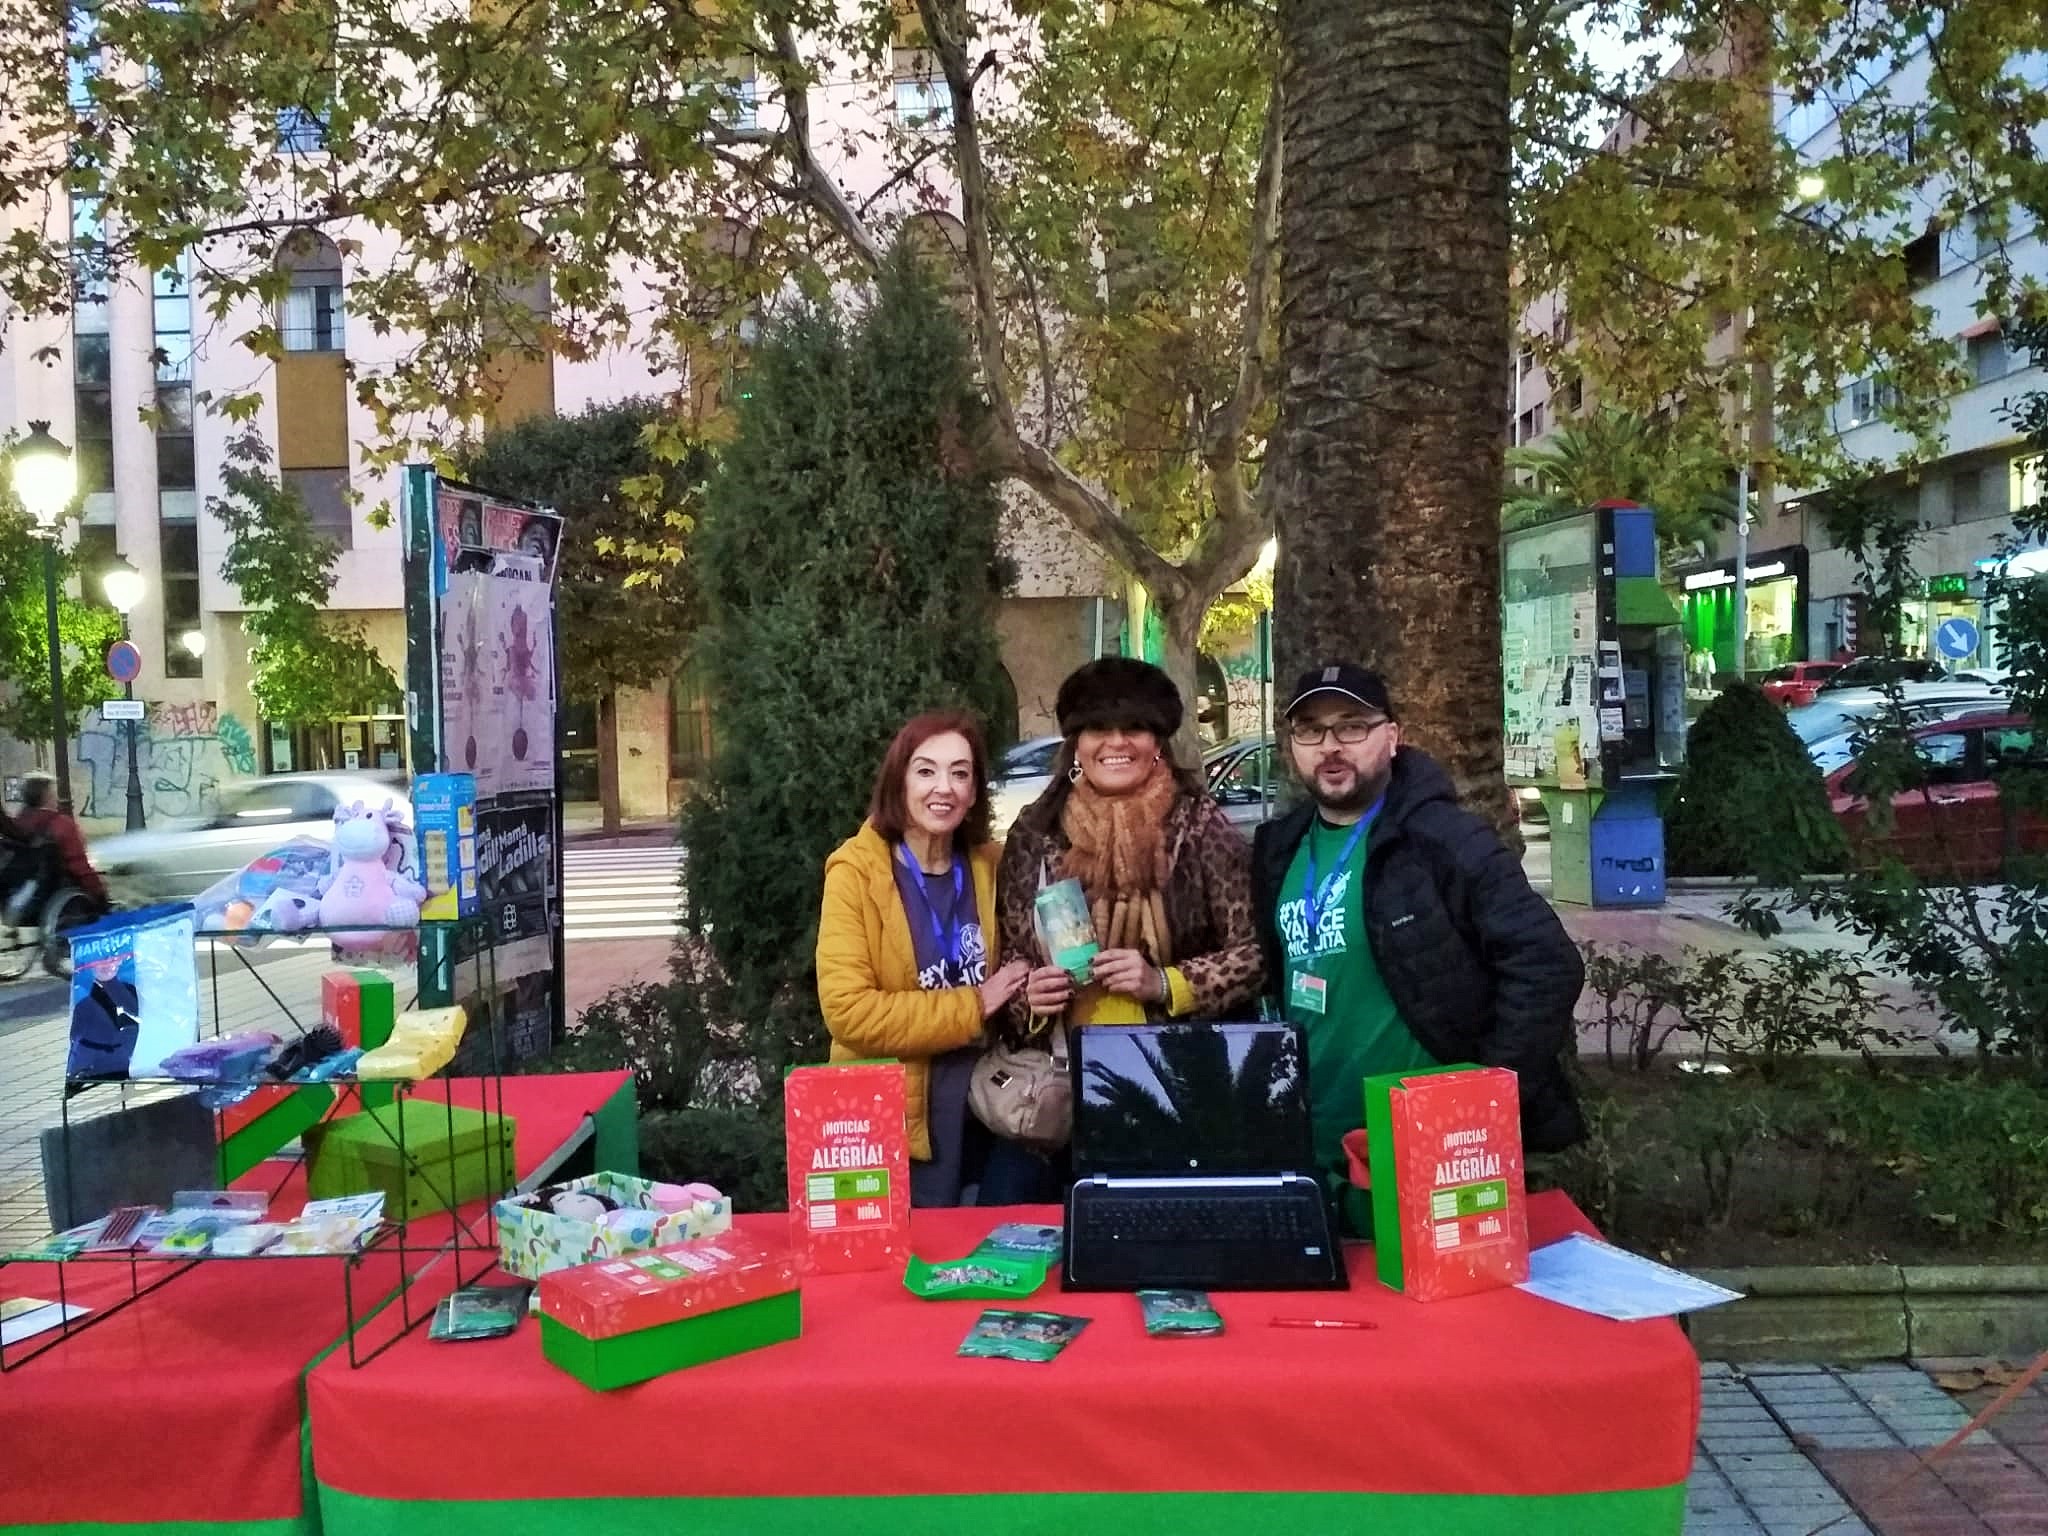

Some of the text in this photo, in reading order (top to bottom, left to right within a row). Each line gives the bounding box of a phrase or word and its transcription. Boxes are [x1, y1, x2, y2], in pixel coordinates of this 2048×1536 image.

[498, 831, 547, 880] Ladilla
[1300, 930, 1347, 954] CJITA
[822, 1119, 871, 1139] ¡NOTICIAS
[1443, 1127, 1488, 1152] ¡NOTICIAS
[811, 1137, 884, 1170] ALEGRÍA!
[1434, 1147, 1501, 1186] ALEGRÍA!
